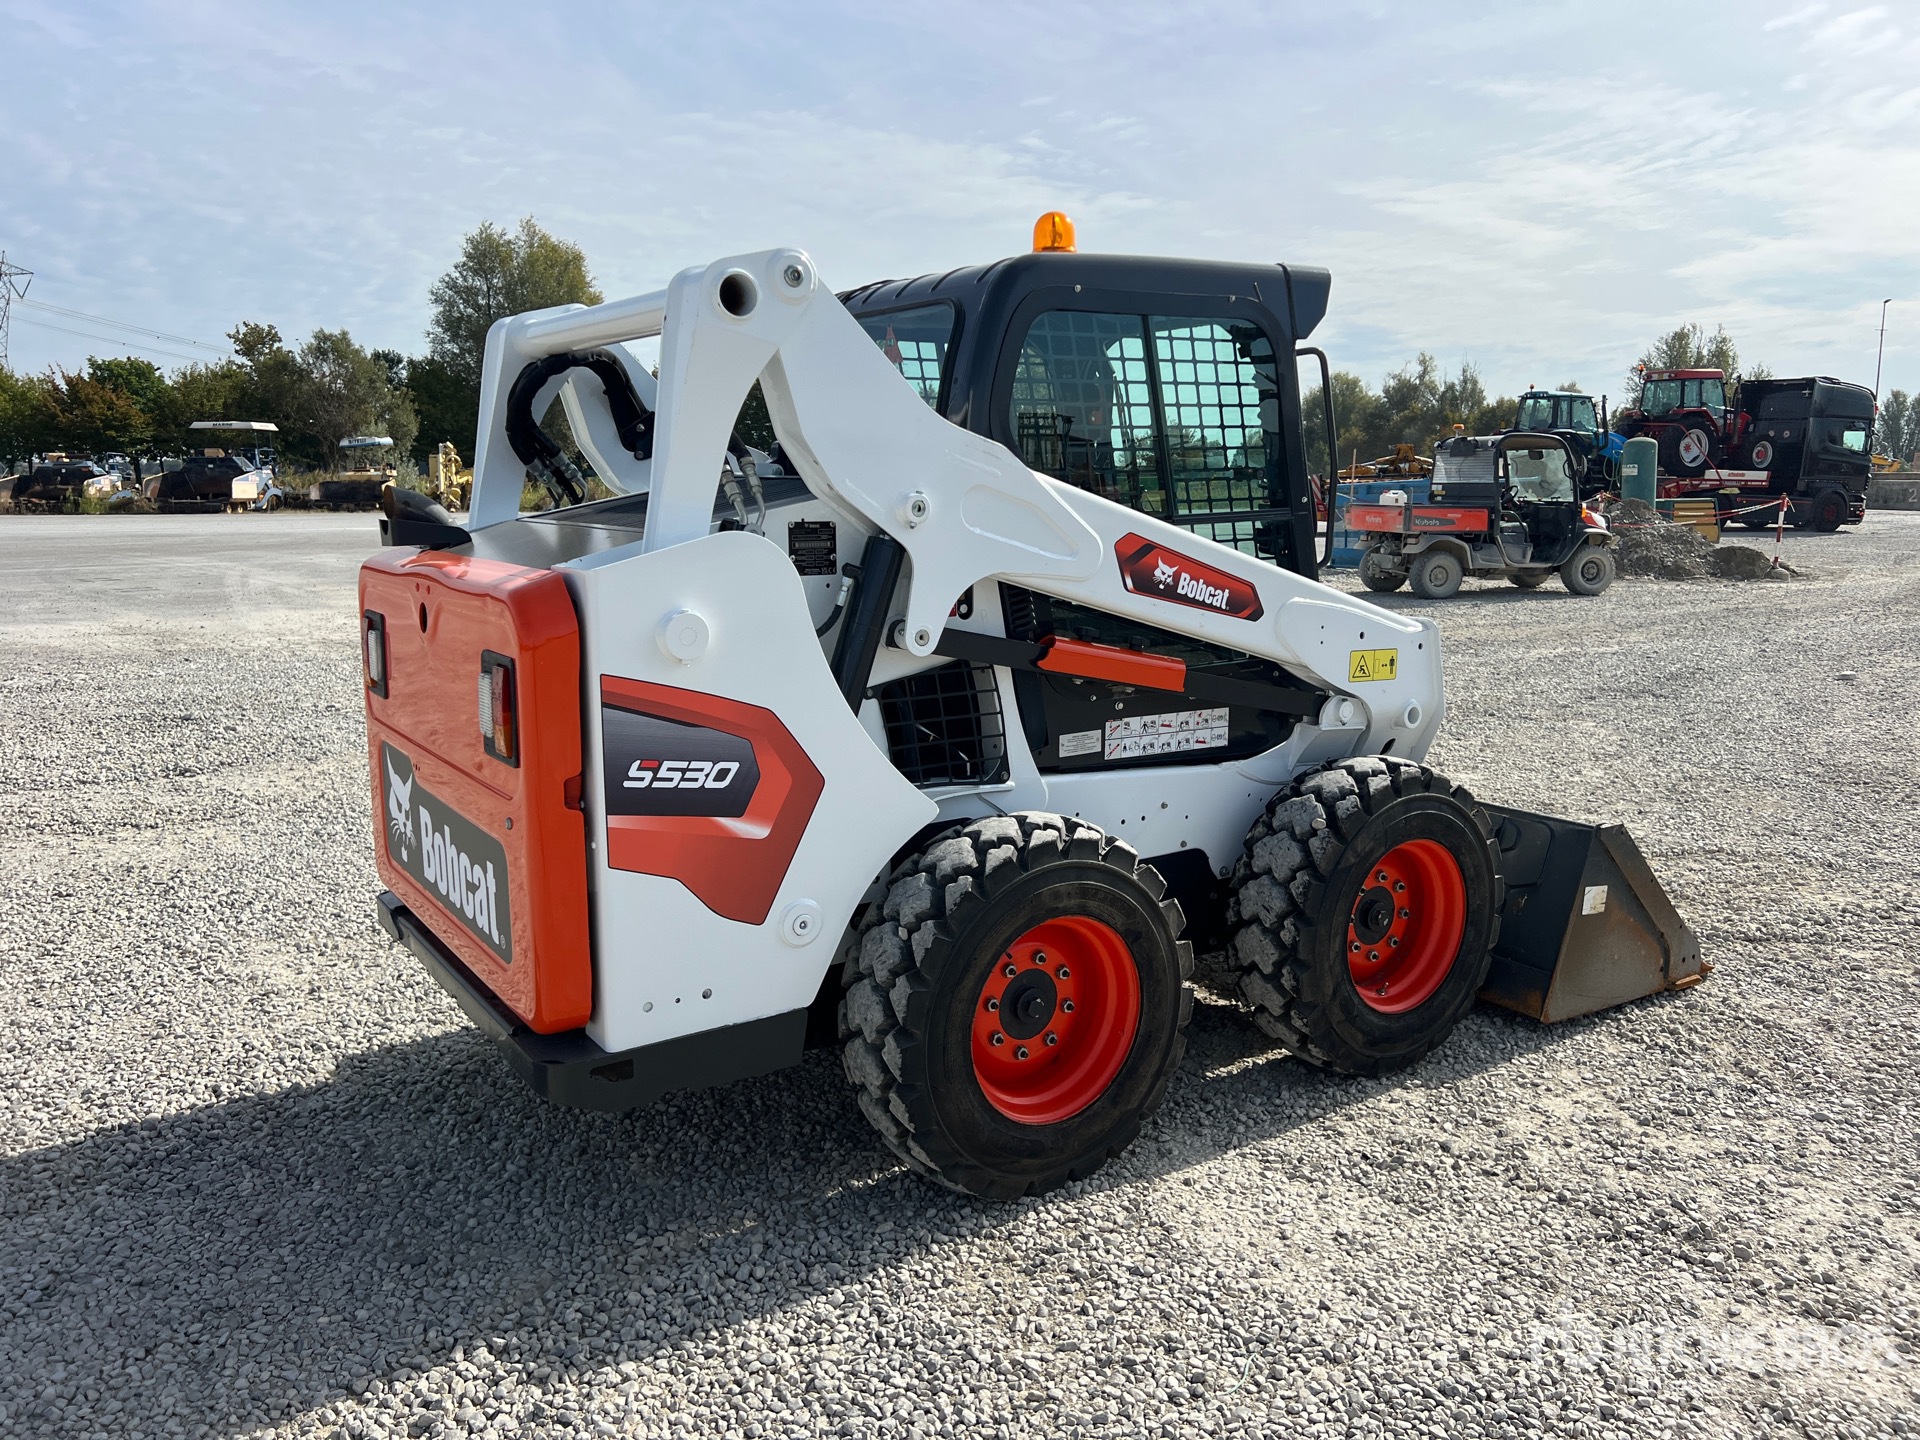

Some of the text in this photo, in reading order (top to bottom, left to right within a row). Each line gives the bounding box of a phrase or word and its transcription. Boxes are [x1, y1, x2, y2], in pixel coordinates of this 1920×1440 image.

[1178, 573, 1229, 609] Bobcat
[622, 760, 741, 788] S530
[418, 805, 501, 944] Bobcat
